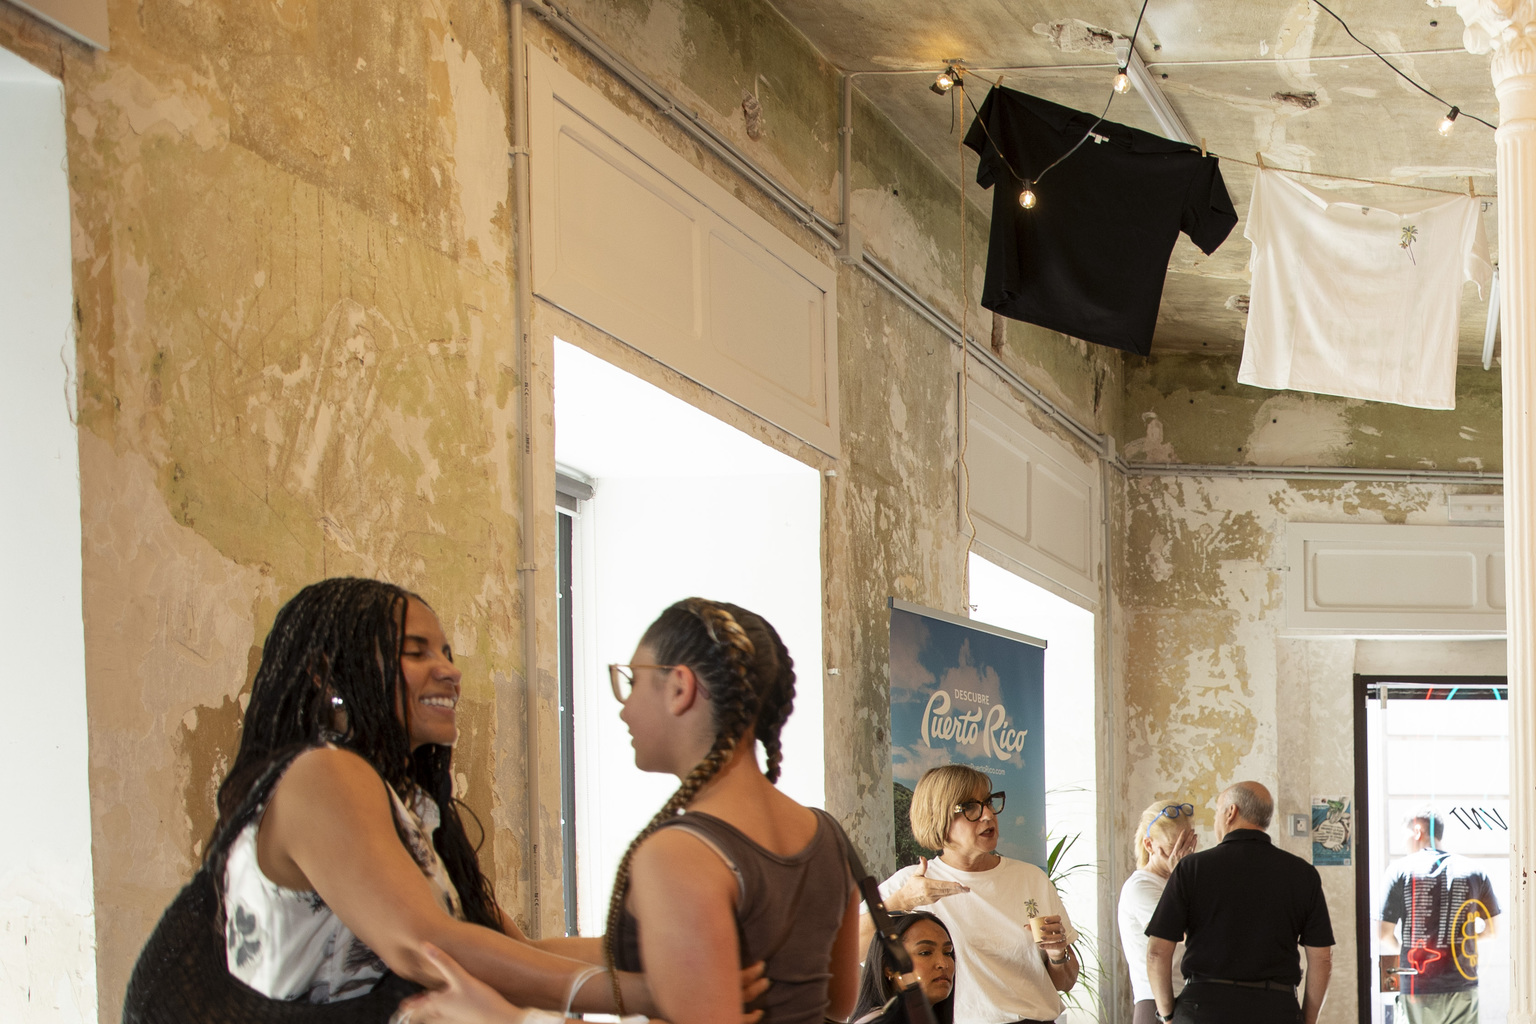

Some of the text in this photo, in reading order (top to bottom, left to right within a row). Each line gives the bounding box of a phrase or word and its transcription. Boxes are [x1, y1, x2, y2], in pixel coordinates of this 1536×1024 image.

[954, 688, 990, 706] DESCUBRE
[920, 689, 1029, 761] Puerto Rico
